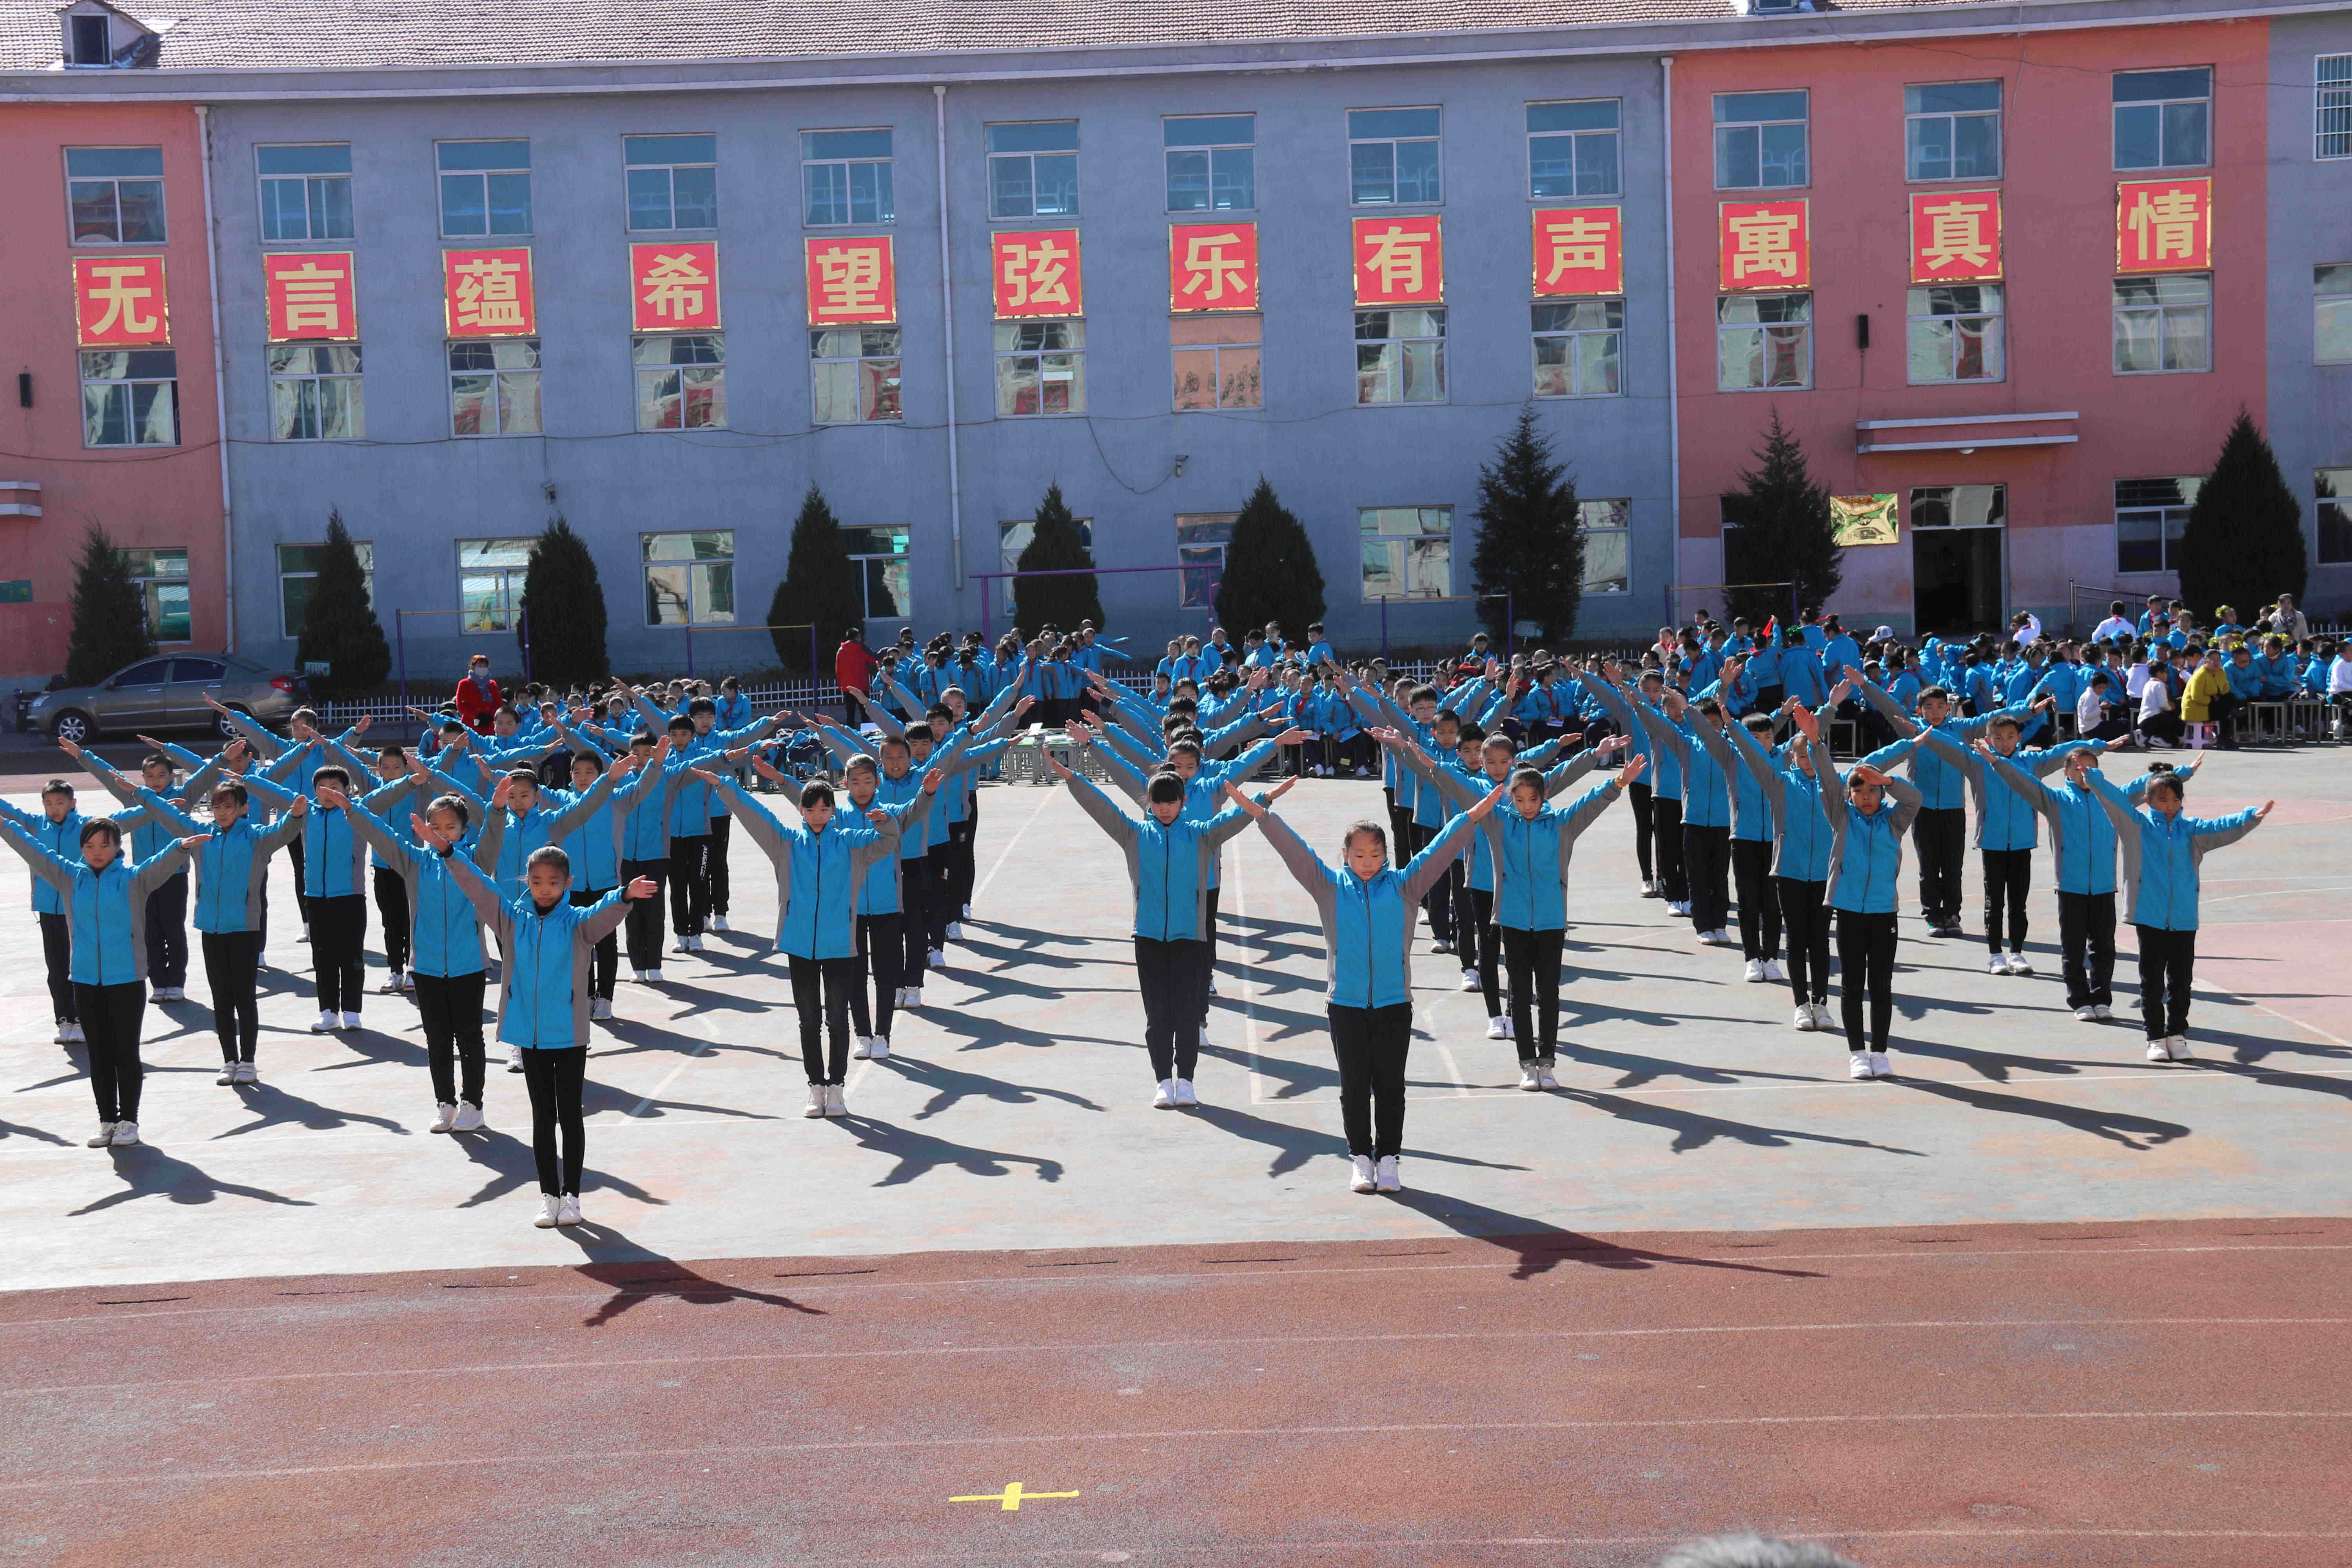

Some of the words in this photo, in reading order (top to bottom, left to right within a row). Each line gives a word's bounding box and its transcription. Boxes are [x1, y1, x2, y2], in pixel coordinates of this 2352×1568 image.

[90, 267, 157, 335] 无
[276, 263, 344, 330] 言
[455, 259, 524, 326] 蕴
[643, 253, 708, 320] 希
[816, 247, 885, 314] 望
[1002, 239, 1071, 306] 弦
[1182, 233, 1248, 300] 乐
[1365, 227, 1430, 293] 有
[1544, 217, 1610, 285] 声
[1730, 211, 1798, 279] 寓
[1922, 201, 1991, 270] 真
[2129, 190, 2199, 260] 情
